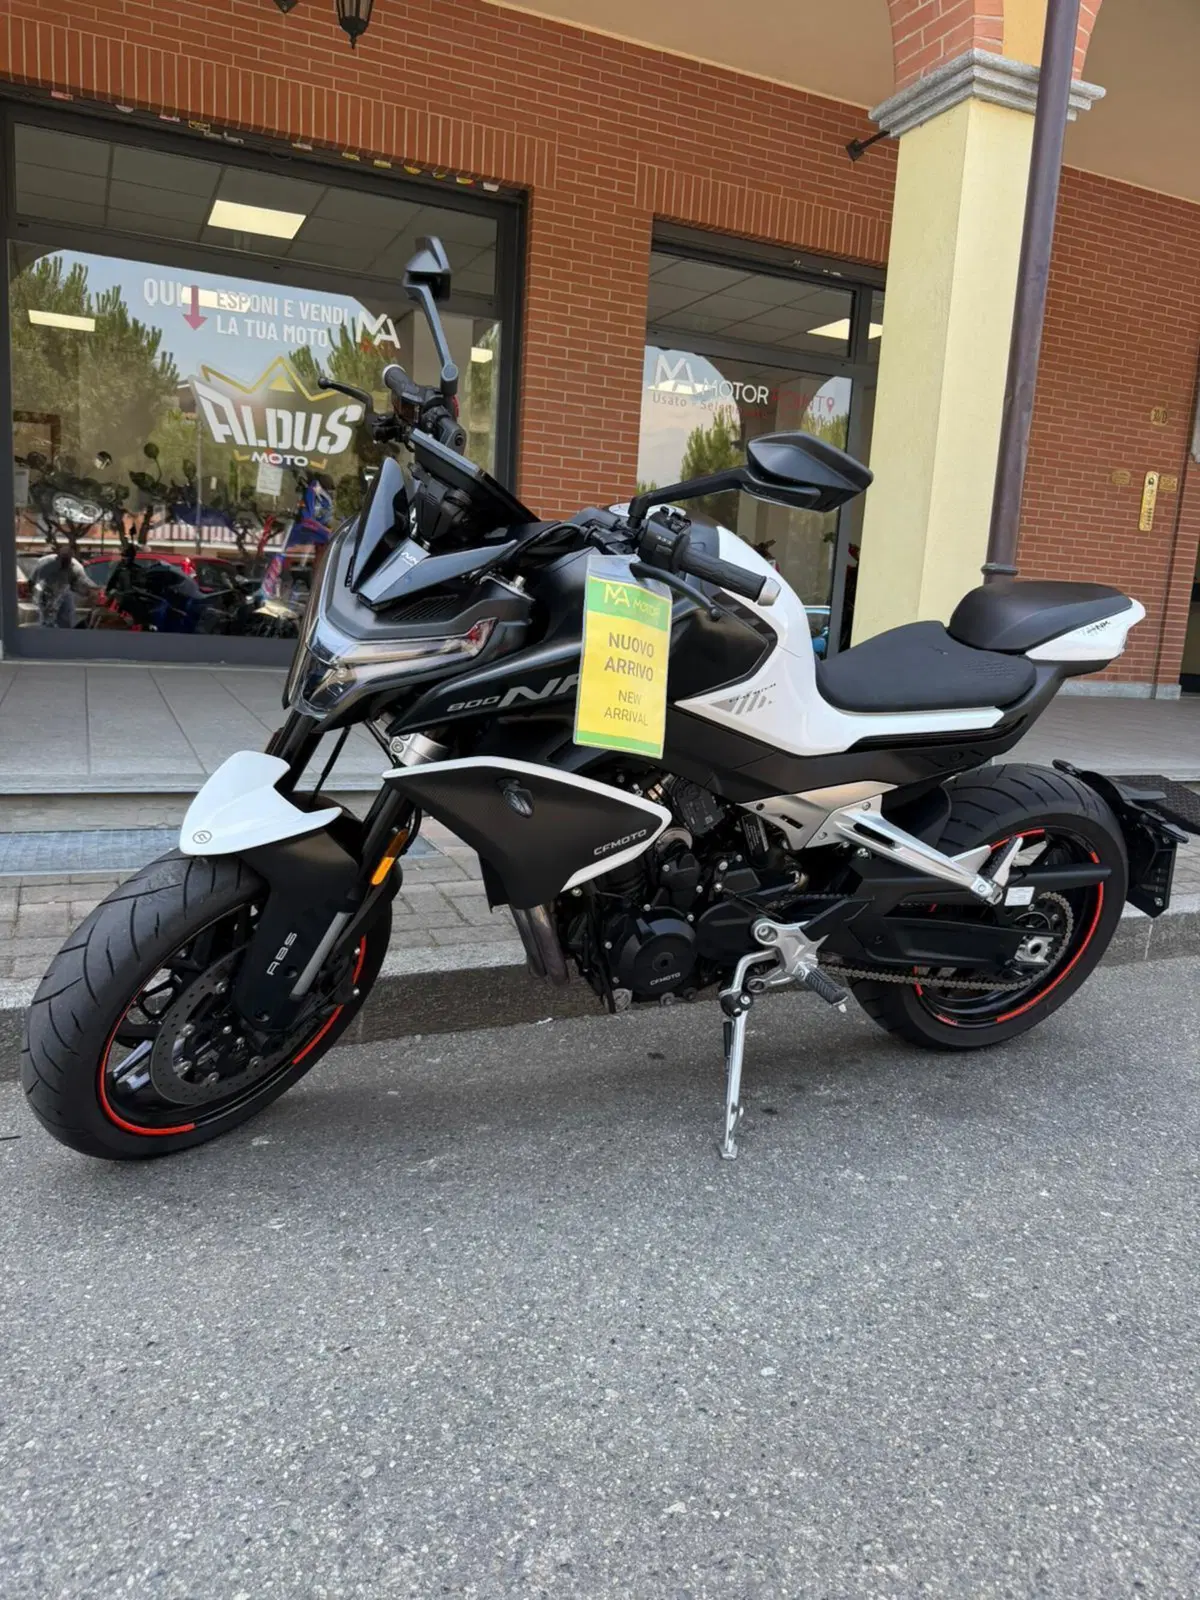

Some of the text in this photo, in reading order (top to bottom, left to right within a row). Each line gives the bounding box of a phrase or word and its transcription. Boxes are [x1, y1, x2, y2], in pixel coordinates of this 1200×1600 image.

[143, 278, 184, 307] QUI
[216, 289, 348, 327] ESPONI E VENDI
[216, 315, 328, 348] LA TUA MOTO
[652, 393, 687, 408] Usato
[702, 377, 769, 406] MOTOR
[191, 379, 363, 455] ALDUS
[251, 452, 309, 467] MOTO
[608, 631, 655, 658] NUOVO
[604, 656, 654, 682] ARRIVO
[618, 689, 642, 706] NEW
[604, 706, 649, 727] ARRIVAL
[593, 829, 647, 856] CFMOTO
[266, 931, 298, 976] ABS
[649, 972, 681, 986] CFMOTO
